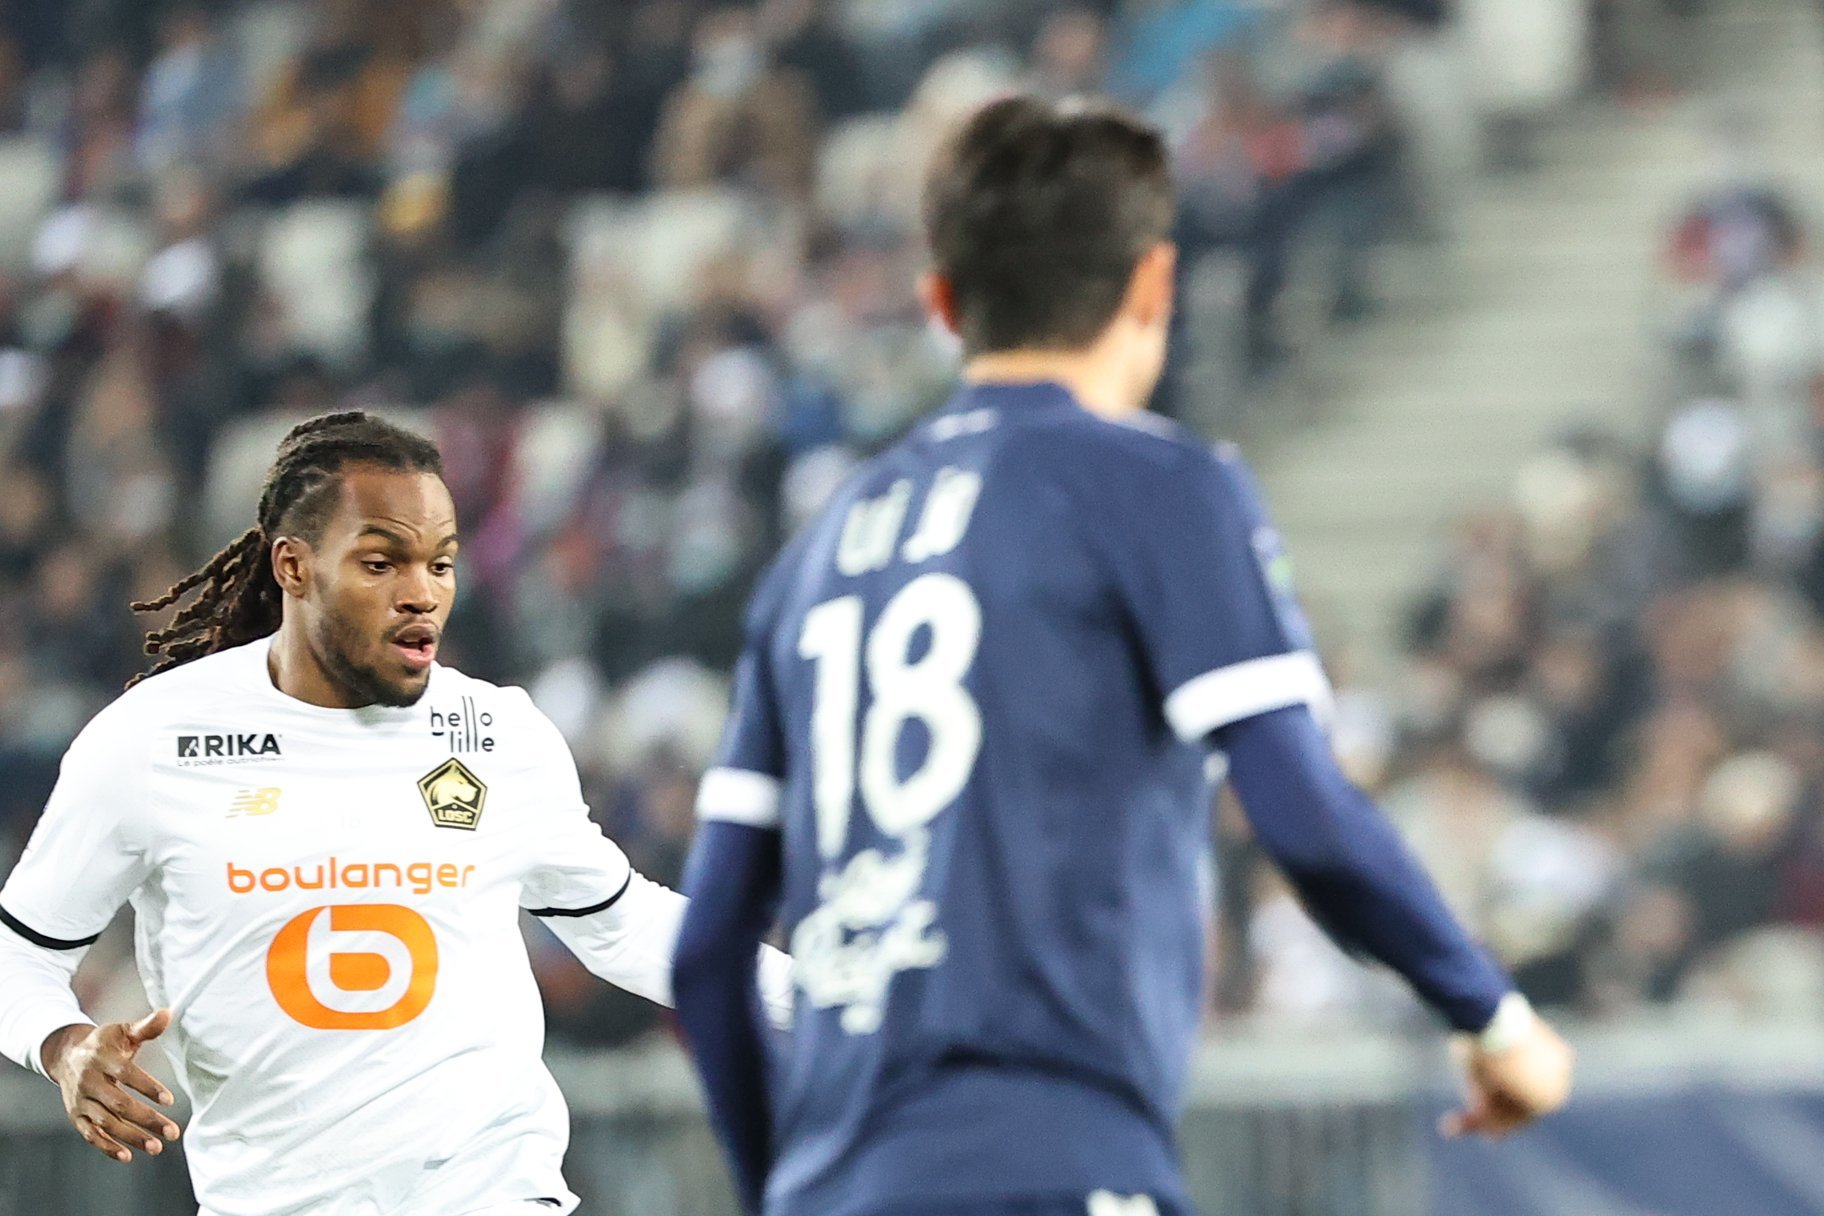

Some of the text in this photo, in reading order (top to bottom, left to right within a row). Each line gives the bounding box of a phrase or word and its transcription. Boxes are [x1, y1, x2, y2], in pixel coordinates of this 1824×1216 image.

[430, 696, 493, 728] hello
[799, 573, 983, 859] 18
[204, 734, 282, 757] RIKA
[227, 856, 476, 895] boulanger
